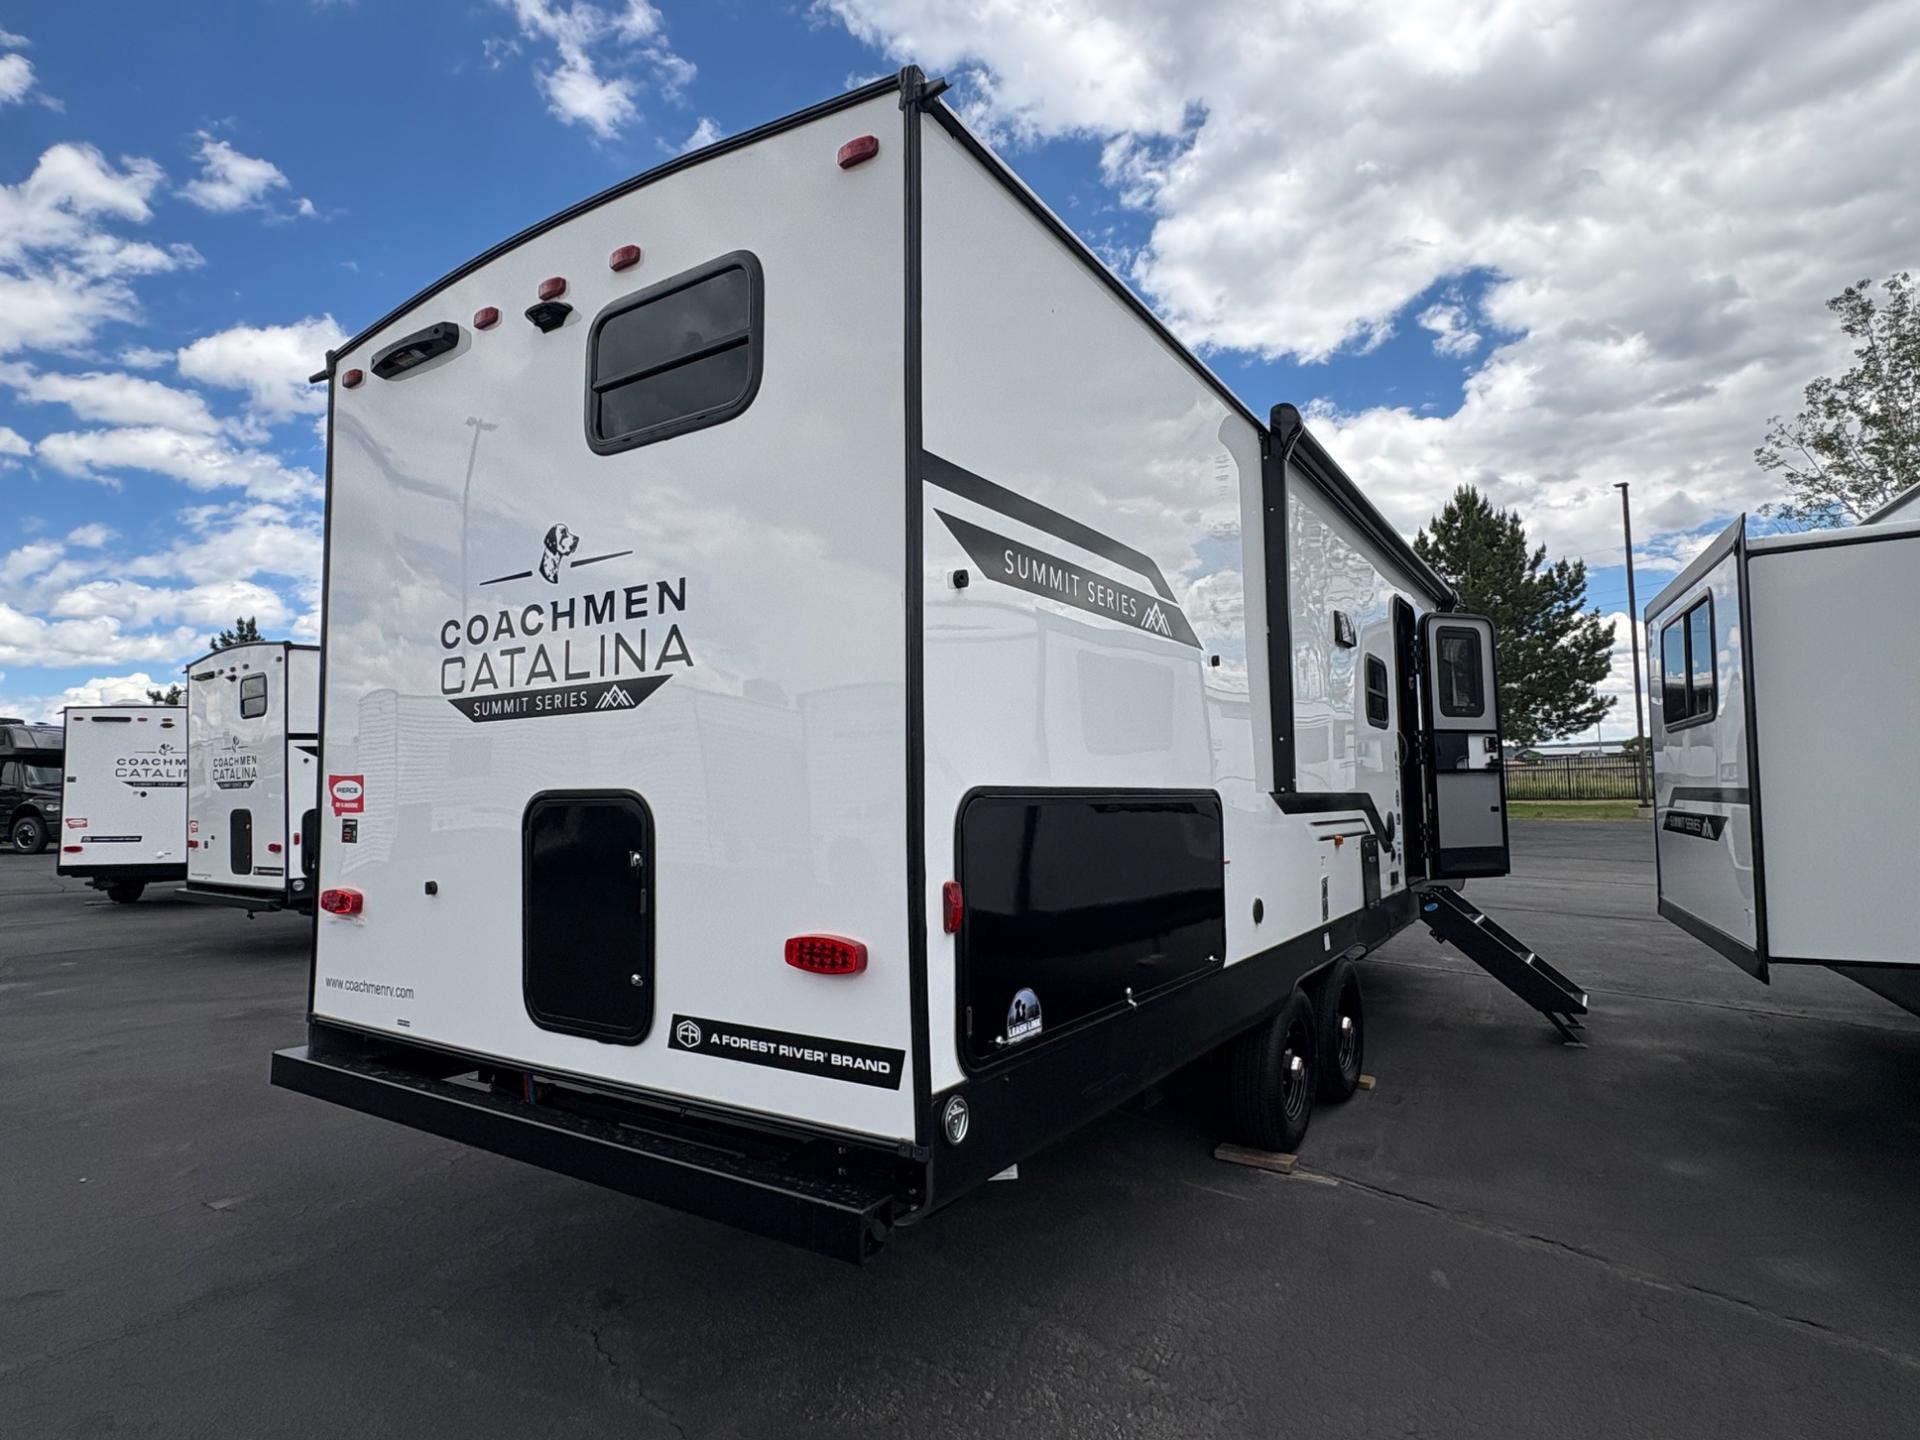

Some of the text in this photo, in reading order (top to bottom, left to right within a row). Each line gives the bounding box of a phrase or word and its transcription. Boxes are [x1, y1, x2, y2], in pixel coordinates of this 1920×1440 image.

[1004, 550, 1137, 618] SUMMIT SERIES
[441, 577, 686, 650] COACHMEN
[441, 624, 694, 695] CATALINA
[473, 691, 588, 717] SUMMIT SERIES
[115, 768, 188, 777] CATALI
[116, 758, 187, 766] COACHM
[212, 766, 258, 781] CATALINA
[213, 755, 257, 768] COACHMEN
[325, 977, 414, 1000] www.coachmenrv.com
[710, 1033, 720, 1044] A
[722, 1035, 777, 1054] FOREST
[831, 1053, 891, 1074] BRAND
